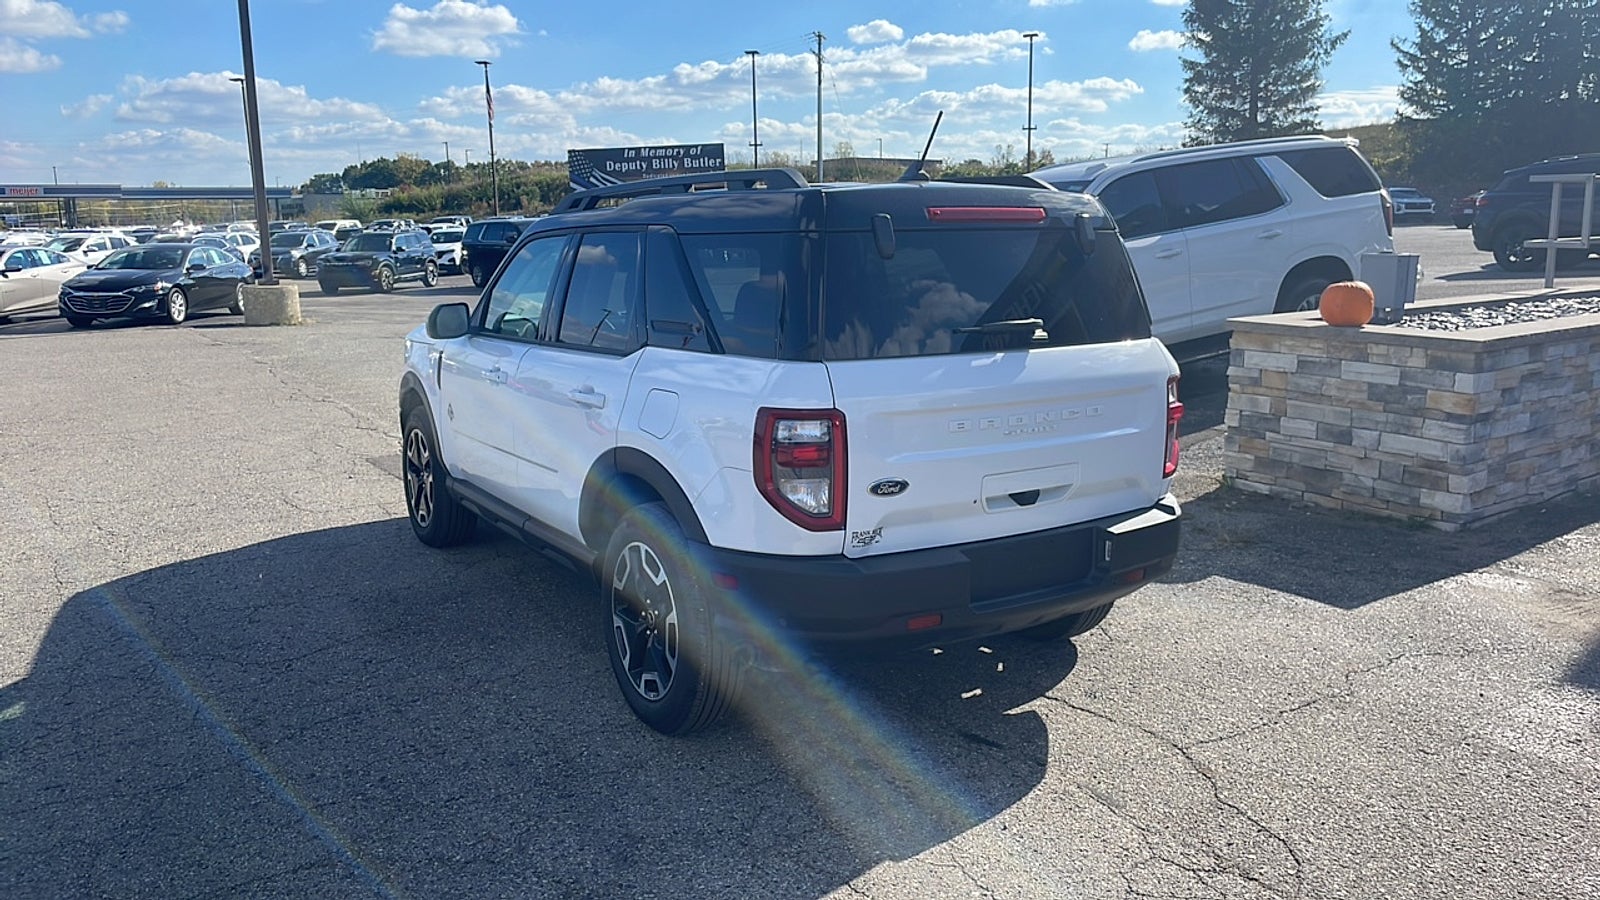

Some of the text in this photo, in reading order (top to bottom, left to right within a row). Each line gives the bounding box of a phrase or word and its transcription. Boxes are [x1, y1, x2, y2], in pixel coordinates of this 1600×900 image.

[624, 146, 702, 158] In Memory of
[606, 156, 722, 173] Deputy Billy Butler
[9, 187, 38, 197] meijer
[949, 405, 1104, 433] BRONCO
[877, 482, 901, 494] Ford
